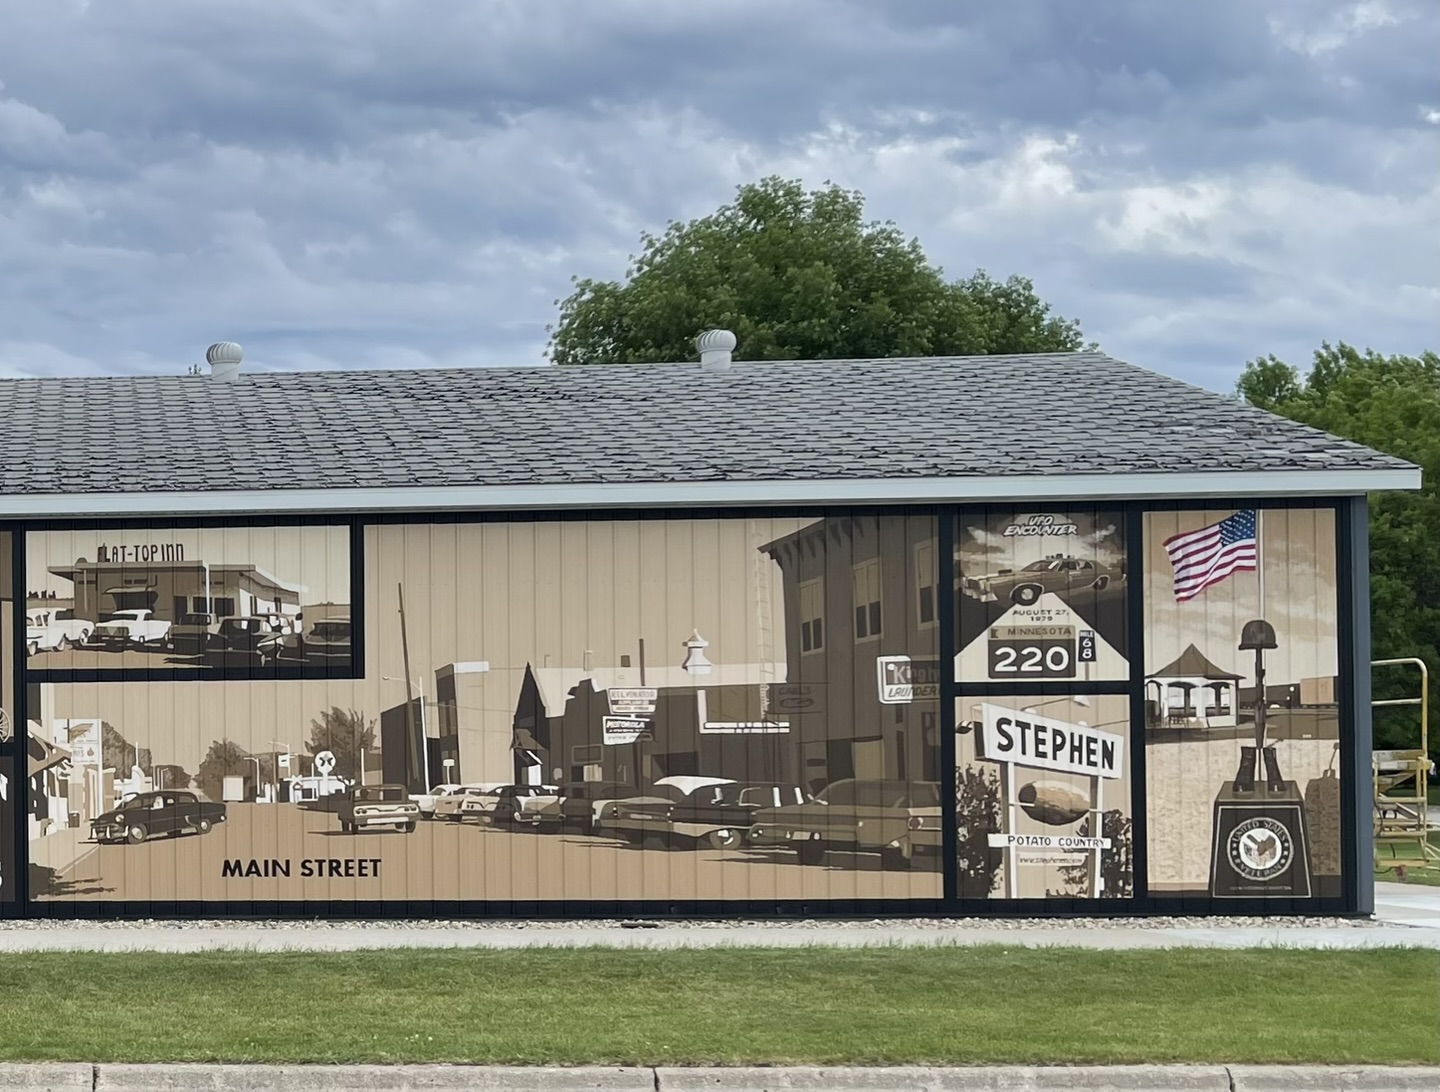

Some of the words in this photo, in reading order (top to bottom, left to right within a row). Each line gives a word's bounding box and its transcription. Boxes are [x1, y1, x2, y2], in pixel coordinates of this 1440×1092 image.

[1028, 515, 1054, 526] UFO
[1003, 524, 1078, 537] ENCOUNTER
[1007, 627, 1072, 636] MINNESOTA
[994, 646, 1070, 672] 220
[995, 717, 1115, 771] STEPHEN
[1232, 820, 1260, 842] UNITED
[1263, 820, 1287, 842] STATES
[1008, 835, 1052, 847] POTATO
[1058, 837, 1106, 848] COUNTRY
[221, 858, 291, 878] MAIN
[300, 858, 382, 878] STREET
